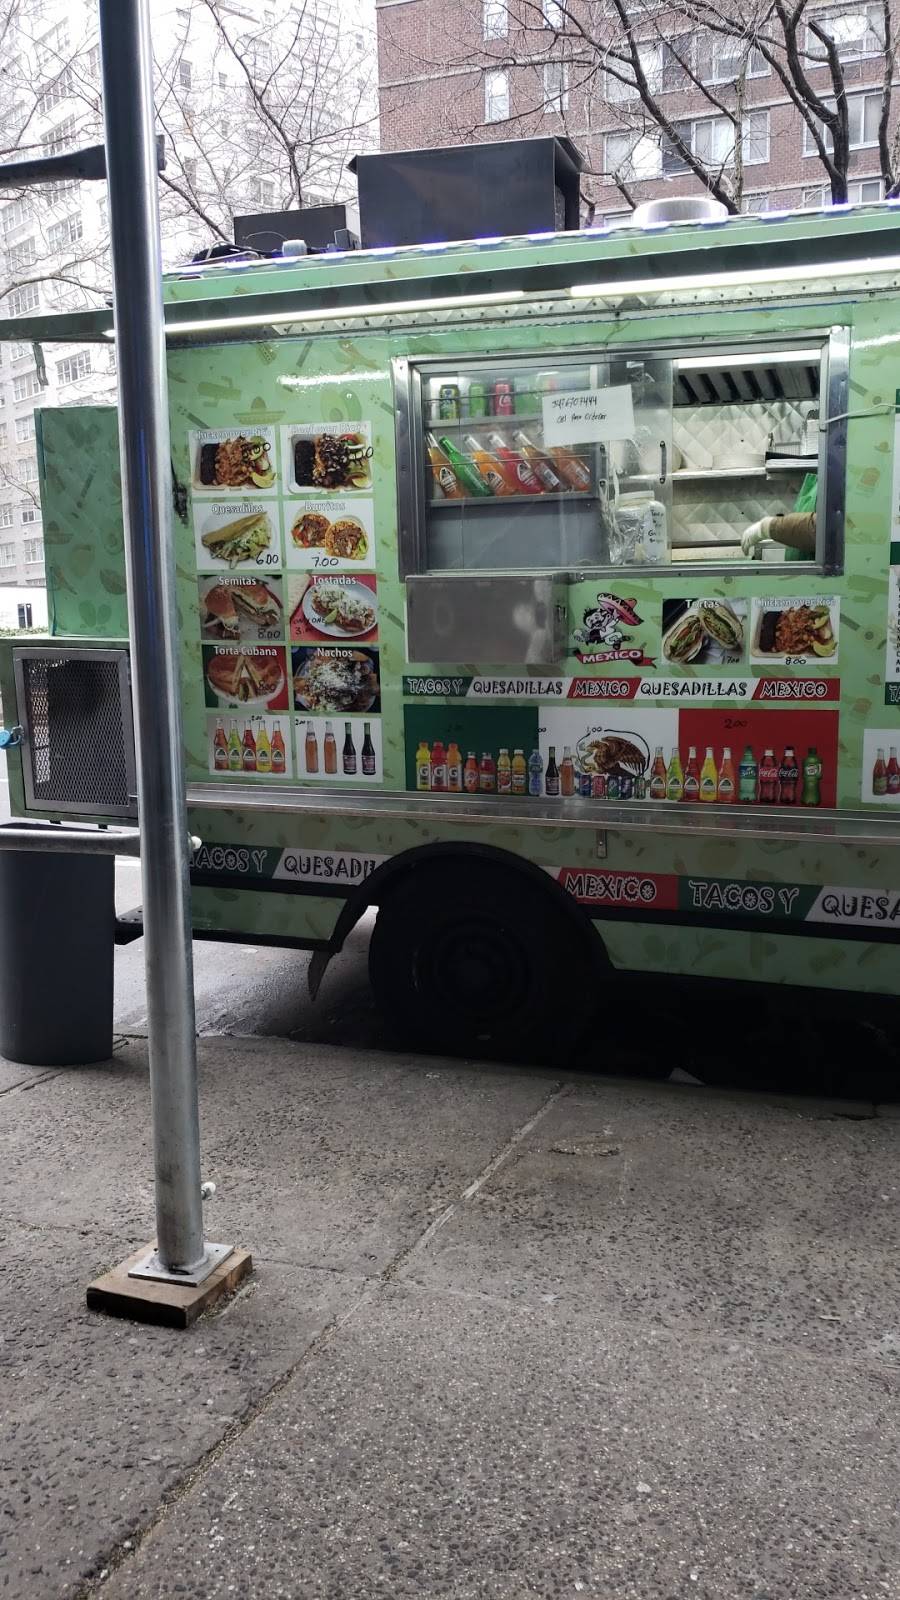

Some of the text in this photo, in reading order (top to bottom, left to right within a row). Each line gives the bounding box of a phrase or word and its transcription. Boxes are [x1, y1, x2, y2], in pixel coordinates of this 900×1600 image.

[211, 502, 264, 515] Quesadillas
[304, 501, 346, 512] Burritos
[219, 576, 257, 586] Semitas
[312, 575, 356, 585] Tostadas
[685, 599, 720, 609] Tortas
[214, 646, 277, 656] Torta Cubana
[317, 647, 353, 658] Nachos
[582, 650, 642, 663] MEXICO
[406, 678, 828, 698] TACOS Y QUESADILLAS MEXICO QUESADILLAS MEXICO
[189, 846, 250, 872] ACOS
[251, 850, 268, 874] Y
[565, 873, 657, 902] MEXICO
[688, 879, 775, 913] TACOS
[778, 887, 800, 915] Y
